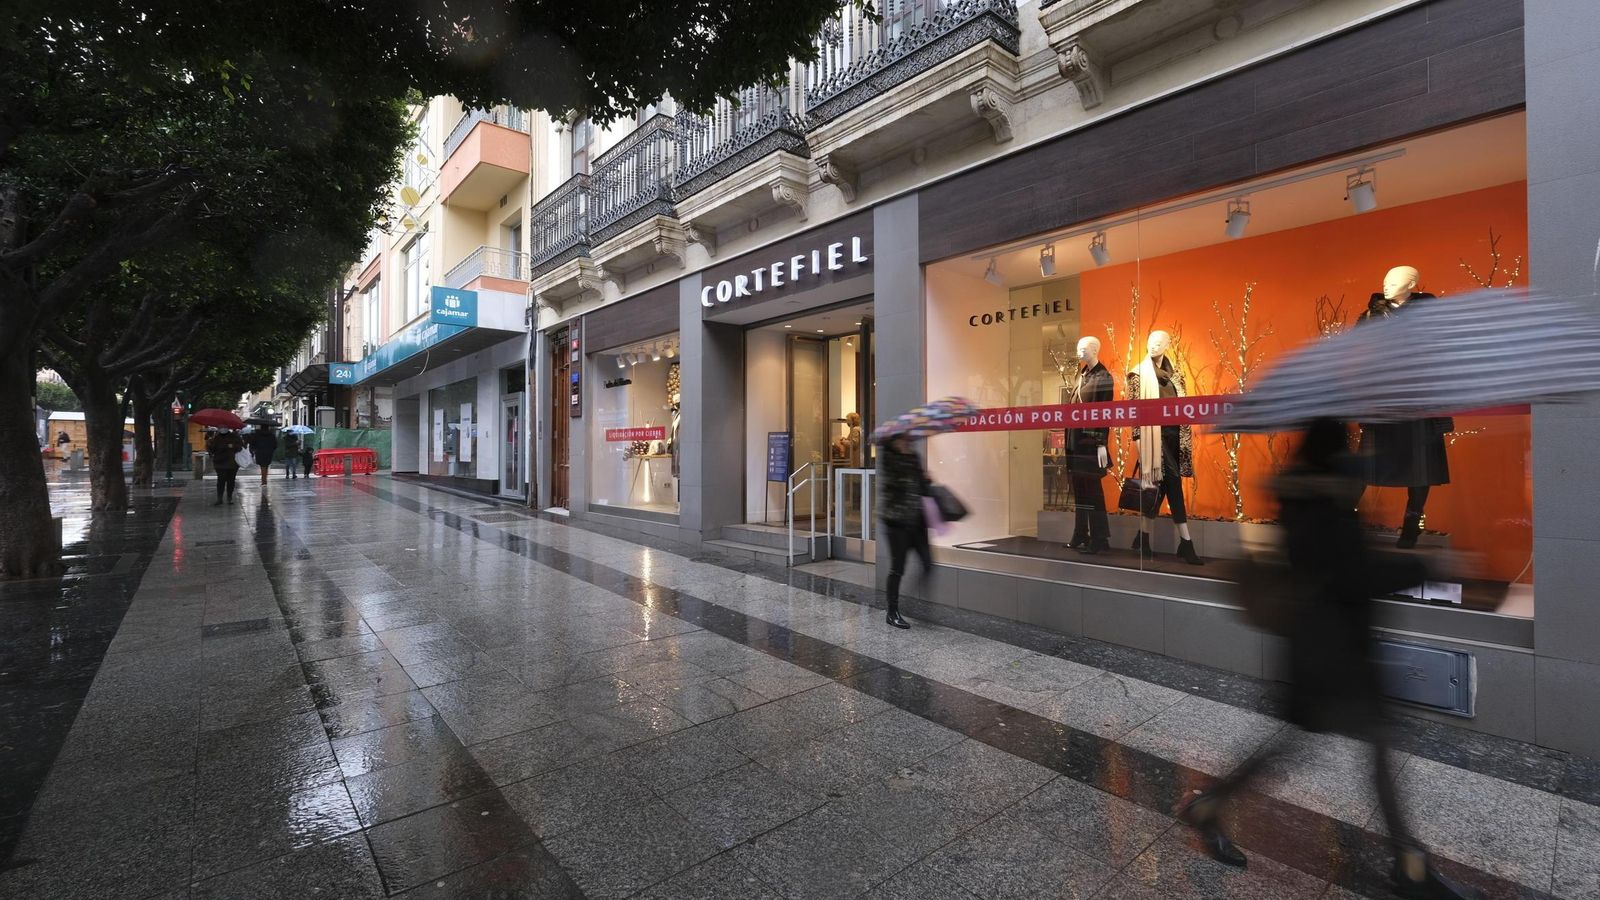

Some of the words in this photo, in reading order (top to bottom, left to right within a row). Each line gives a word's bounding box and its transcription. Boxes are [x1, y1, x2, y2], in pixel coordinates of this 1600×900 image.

[701, 236, 868, 307] CORTEFIEL
[436, 308, 469, 317] cajamar
[969, 299, 1075, 327] CORTEFIEL
[962, 411, 1024, 426] IDACIÓN
[1031, 411, 1063, 423] POR
[1071, 407, 1138, 421] CIERRE
